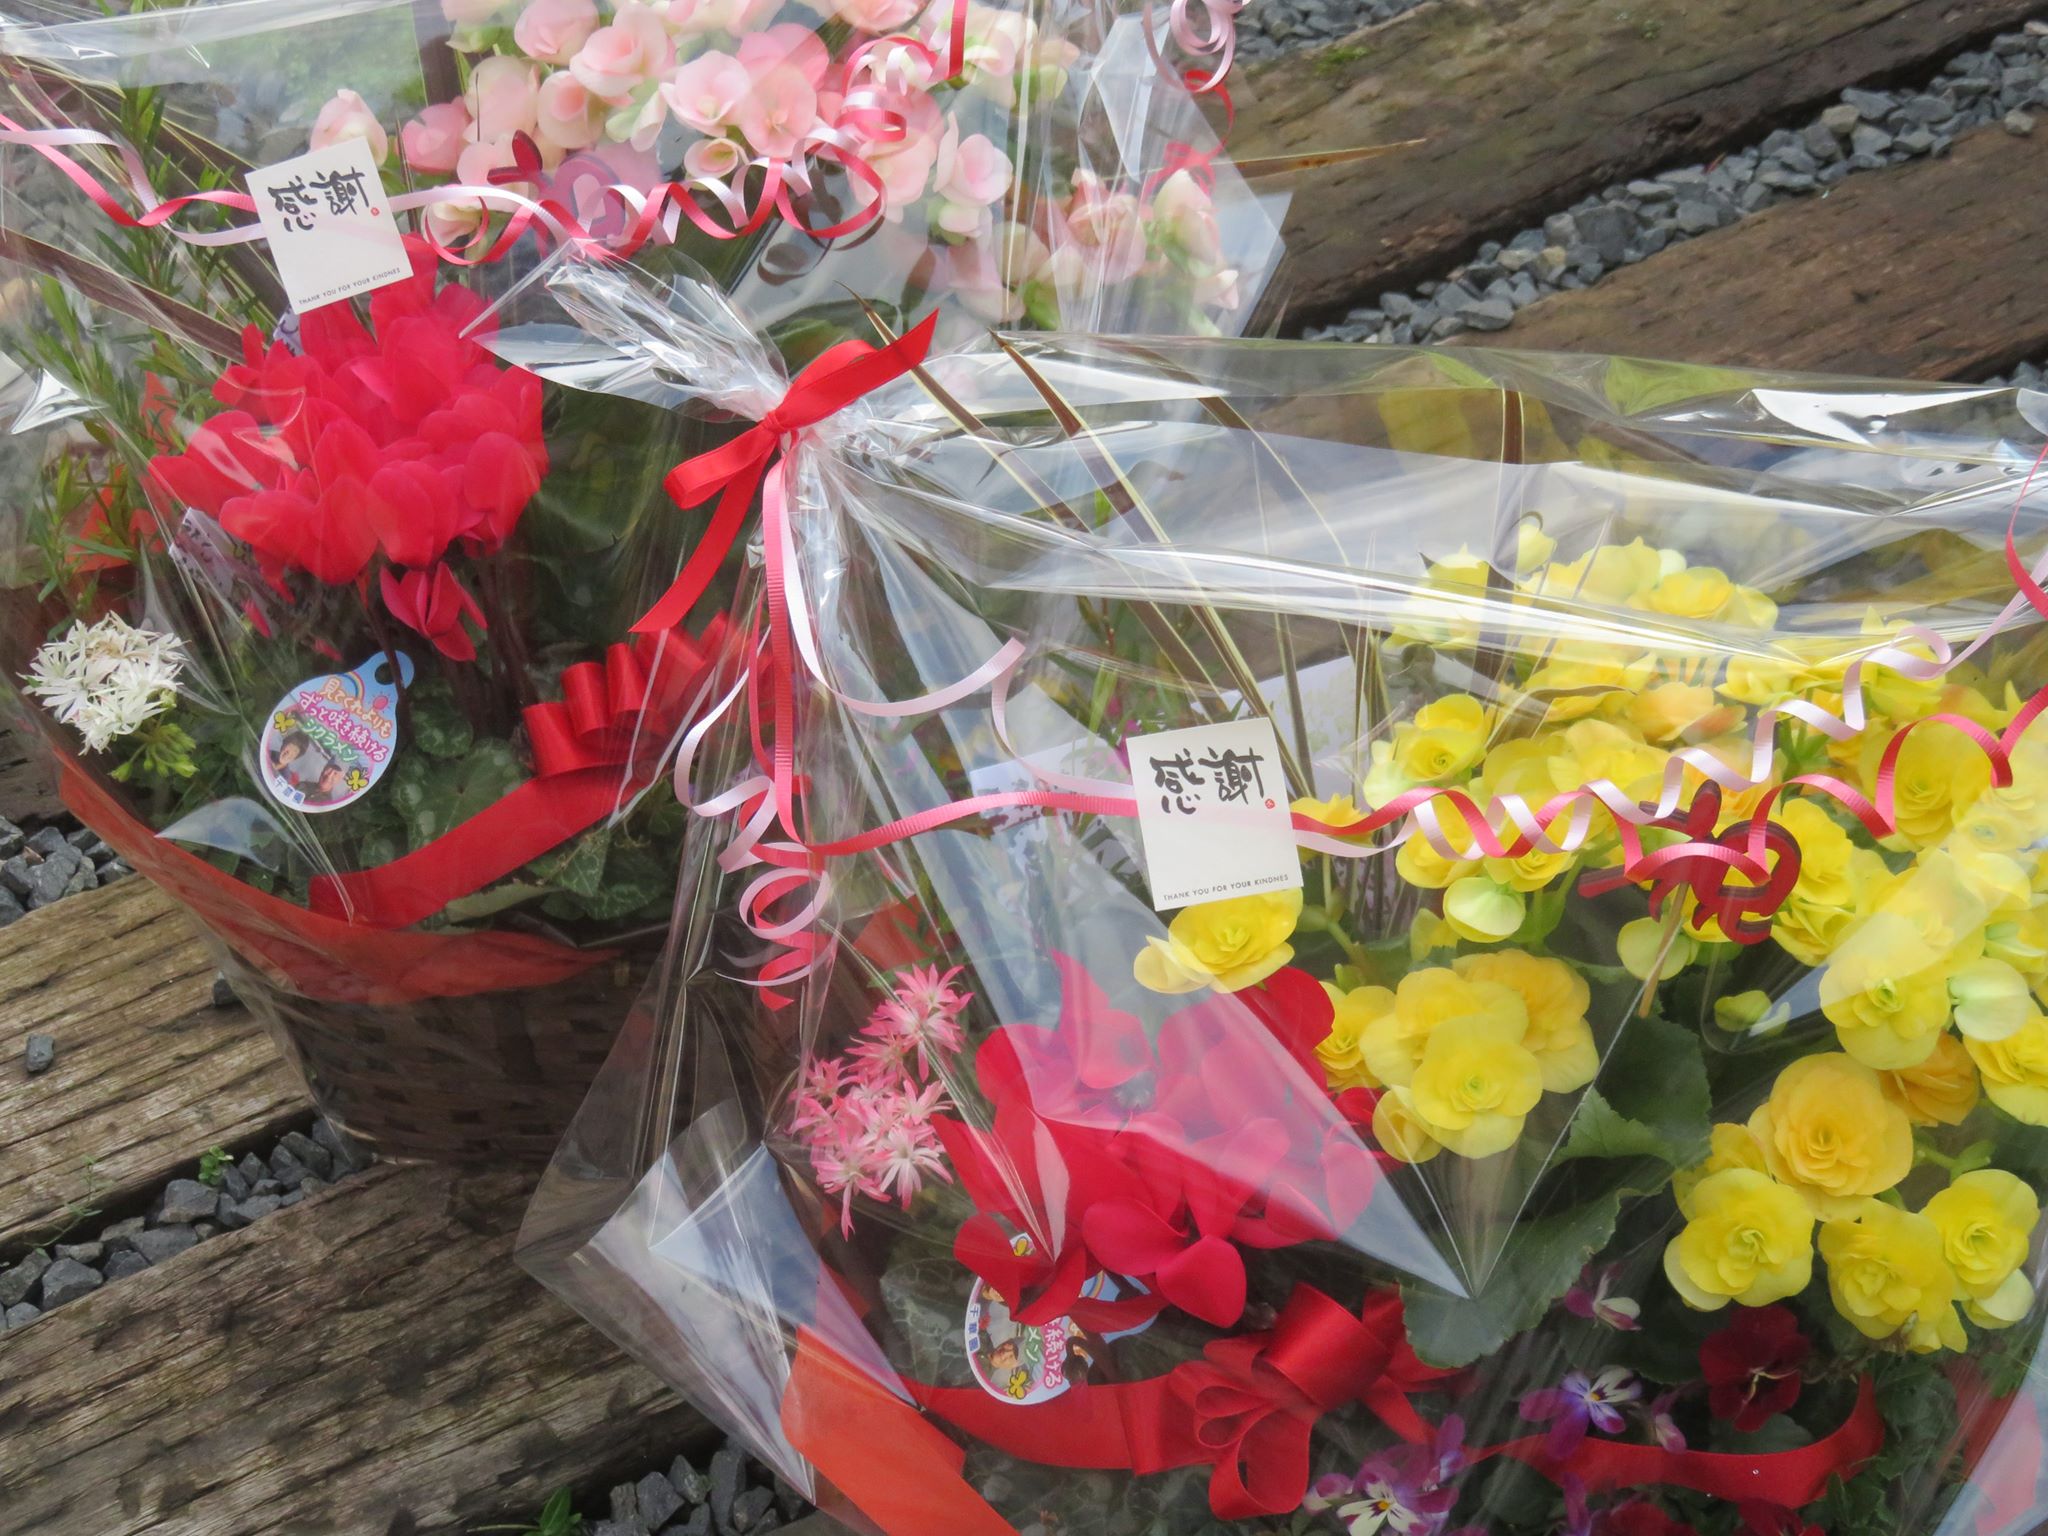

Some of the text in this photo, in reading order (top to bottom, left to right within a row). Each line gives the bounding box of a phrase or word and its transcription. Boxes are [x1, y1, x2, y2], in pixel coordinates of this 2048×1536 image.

[267, 166, 369, 232] 感謝
[298, 292, 321, 305] THANK
[323, 288, 337, 297] YOU
[338, 284, 351, 293] FOR
[353, 277, 371, 288] YOUR
[300, 692, 388, 762] ずっと咲き続ける
[322, 677, 392, 738] 見てくれよりも
[302, 719, 360, 763] シクラメン
[1149, 746, 1265, 815] 感謝
[1163, 873, 1289, 902] THANK YOU FOR YOUR KINDNES
